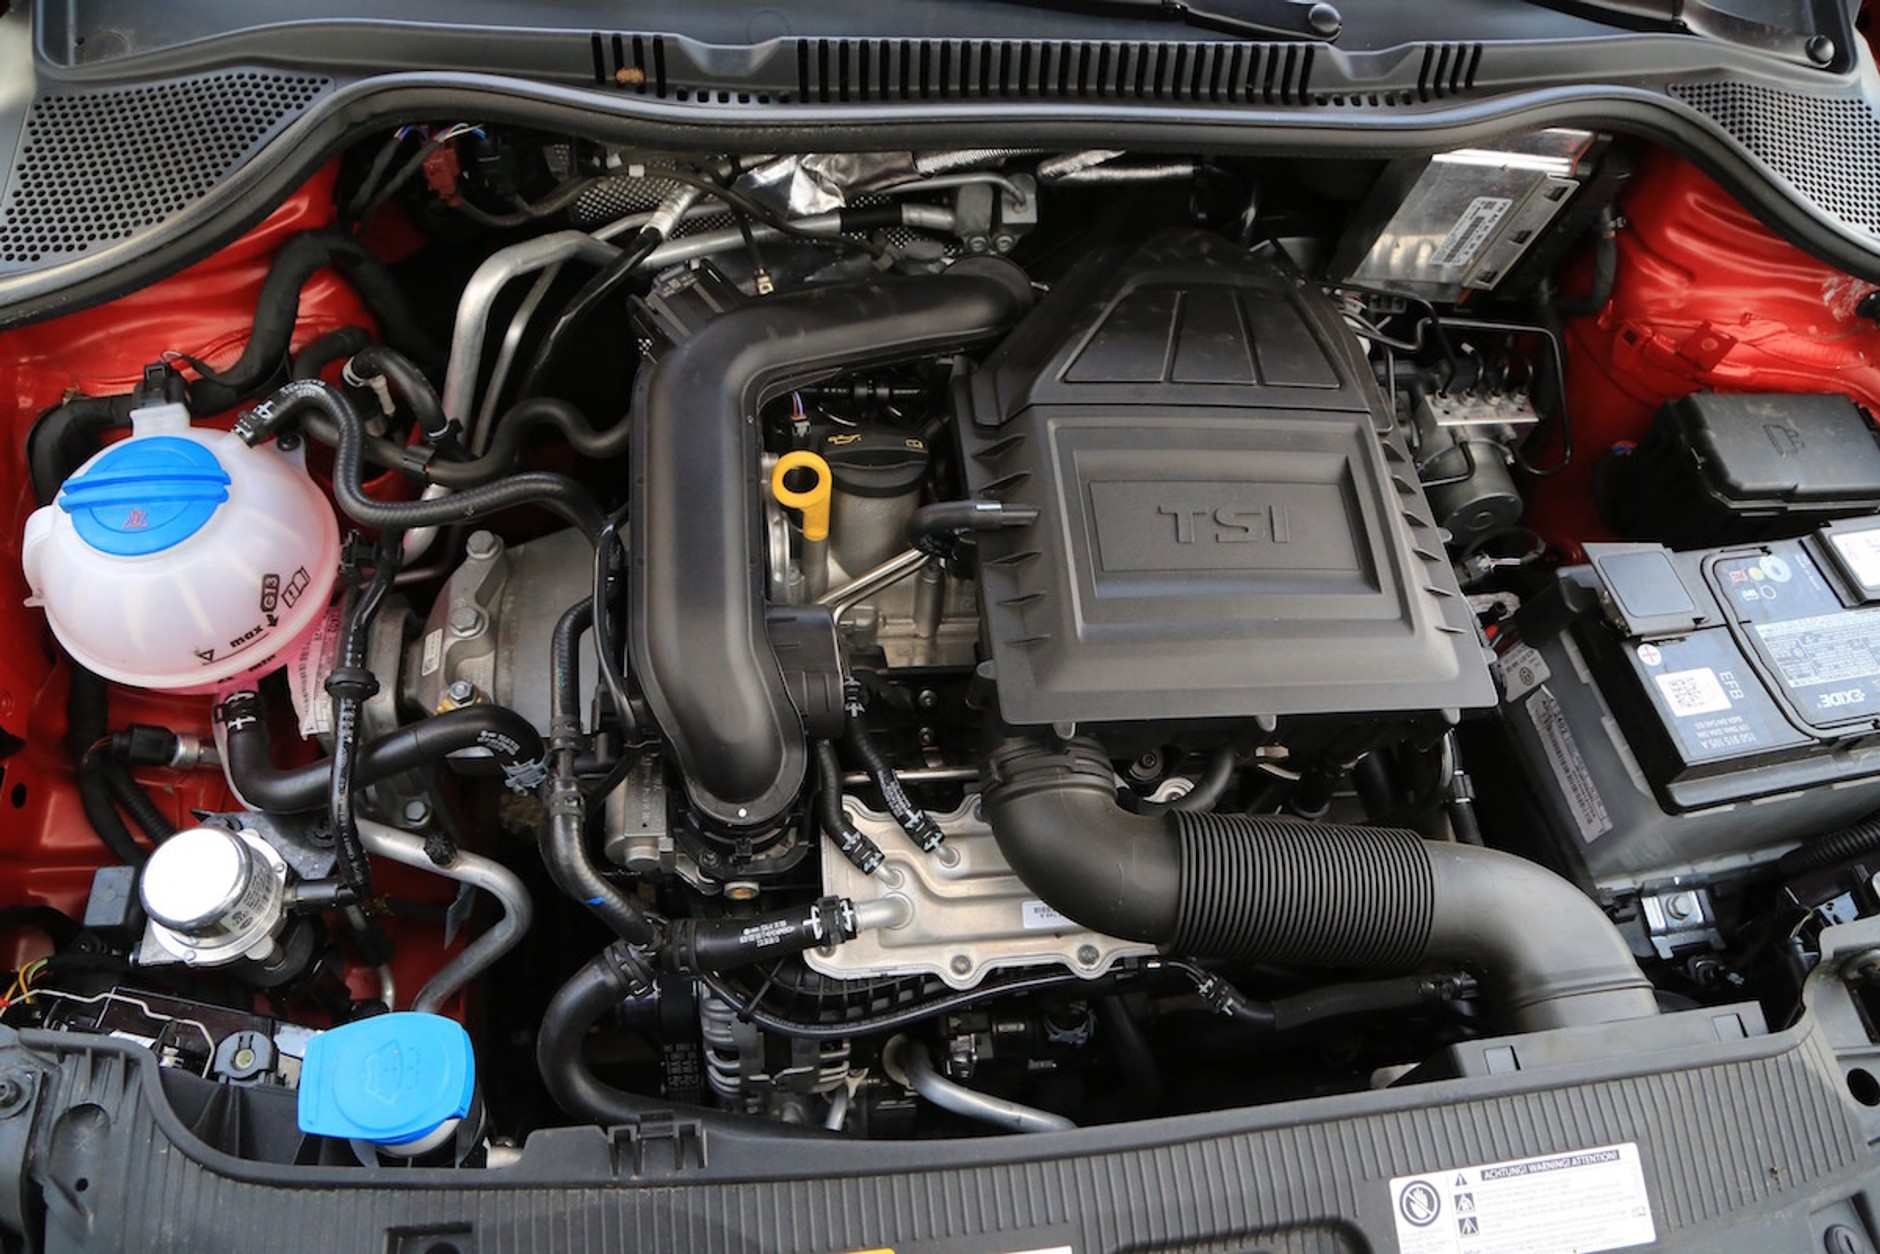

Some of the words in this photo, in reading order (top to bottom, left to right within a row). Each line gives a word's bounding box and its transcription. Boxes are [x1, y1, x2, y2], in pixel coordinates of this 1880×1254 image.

[1158, 504, 1290, 545] TSI
[263, 577, 277, 608] G13
[230, 624, 263, 648] max
[1719, 671, 1745, 700] EFB
[1818, 689, 1866, 708] EXIDE
[1483, 1165, 1527, 1180] ACHTUNG!
[1527, 1158, 1570, 1173] WARNING!
[1570, 1151, 1618, 1167] ATTENTION!
